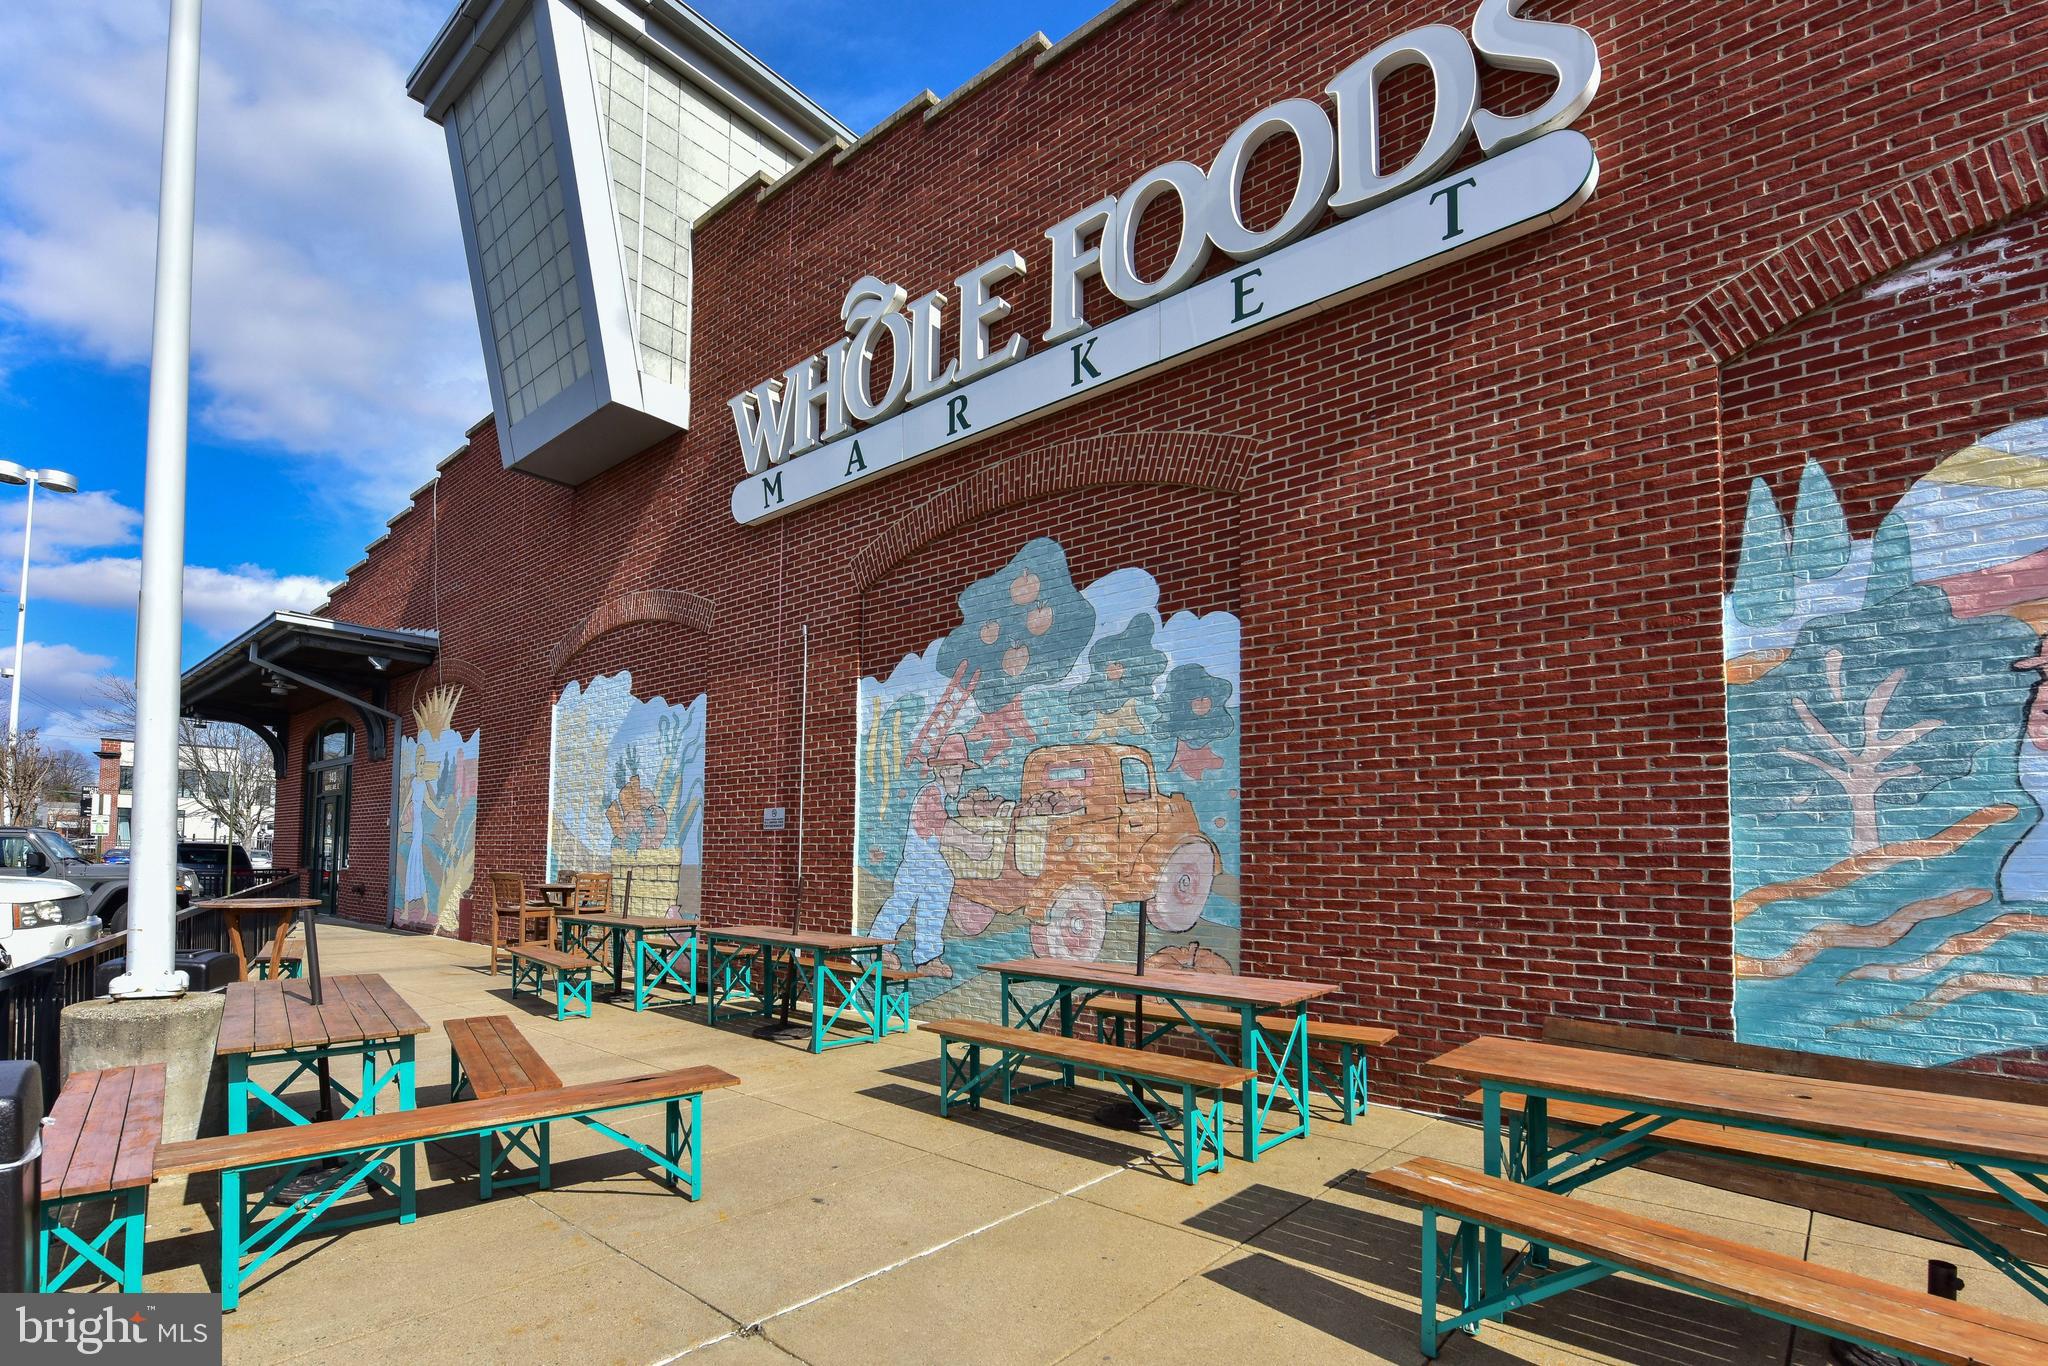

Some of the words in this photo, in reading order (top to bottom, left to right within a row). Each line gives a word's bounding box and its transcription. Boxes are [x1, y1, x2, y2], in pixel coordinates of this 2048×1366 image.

[727, 250, 1027, 474] WHOLE
[1042, 0, 1600, 343] FOODS
[763, 177, 1477, 508] MARKET
